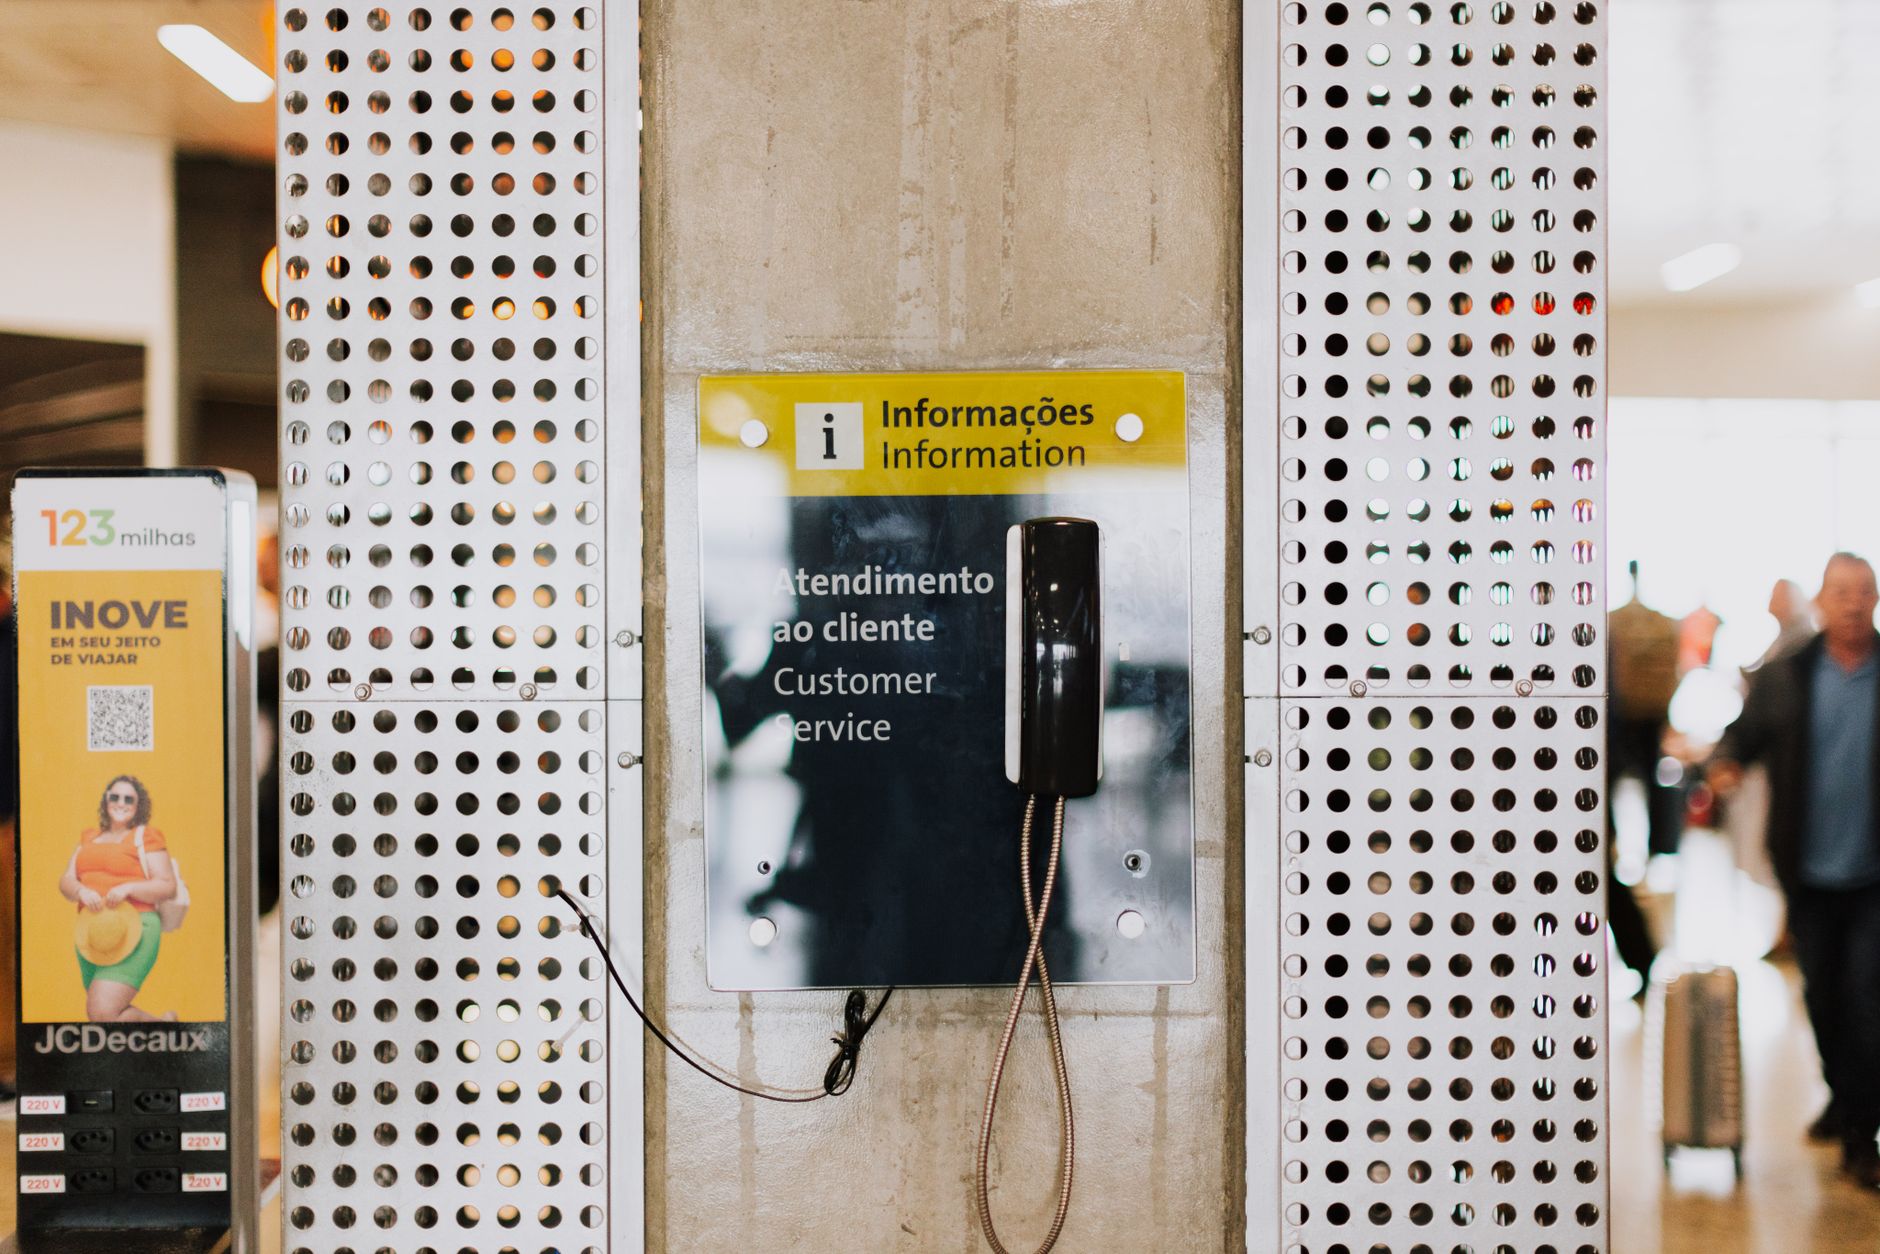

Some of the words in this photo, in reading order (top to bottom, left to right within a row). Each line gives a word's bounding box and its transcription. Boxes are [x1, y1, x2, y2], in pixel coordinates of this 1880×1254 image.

[882, 397, 1094, 435] Informações
[822, 413, 837, 460] i
[882, 438, 1086, 469] Information
[41, 508, 115, 546] 123
[121, 528, 195, 546] milhas
[773, 565, 994, 596] Atendimento
[51, 600, 188, 629] INOVE
[773, 620, 814, 642] ao
[822, 612, 936, 642] cliente
[51, 637, 74, 648] EM
[80, 637, 110, 648] SEU
[115, 637, 161, 648] JEITO
[51, 654, 73, 665] DE
[78, 654, 137, 665] VIAJAR
[773, 666, 937, 696] Customer
[775, 712, 891, 742] Service
[35, 1025, 207, 1053] JCDecaux
[27, 1100, 49, 1110] 220
[51, 1100, 60, 1109] V
[187, 1097, 209, 1108] 220
[212, 1096, 221, 1106] V
[26, 1138, 48, 1148] 220
[51, 1137, 60, 1147] V
[187, 1137, 209, 1147] 220
[212, 1136, 221, 1146] V
[27, 1179, 49, 1189] 220
[51, 1179, 61, 1189] V
[188, 1177, 210, 1188] 220
[214, 1176, 222, 1187] V
